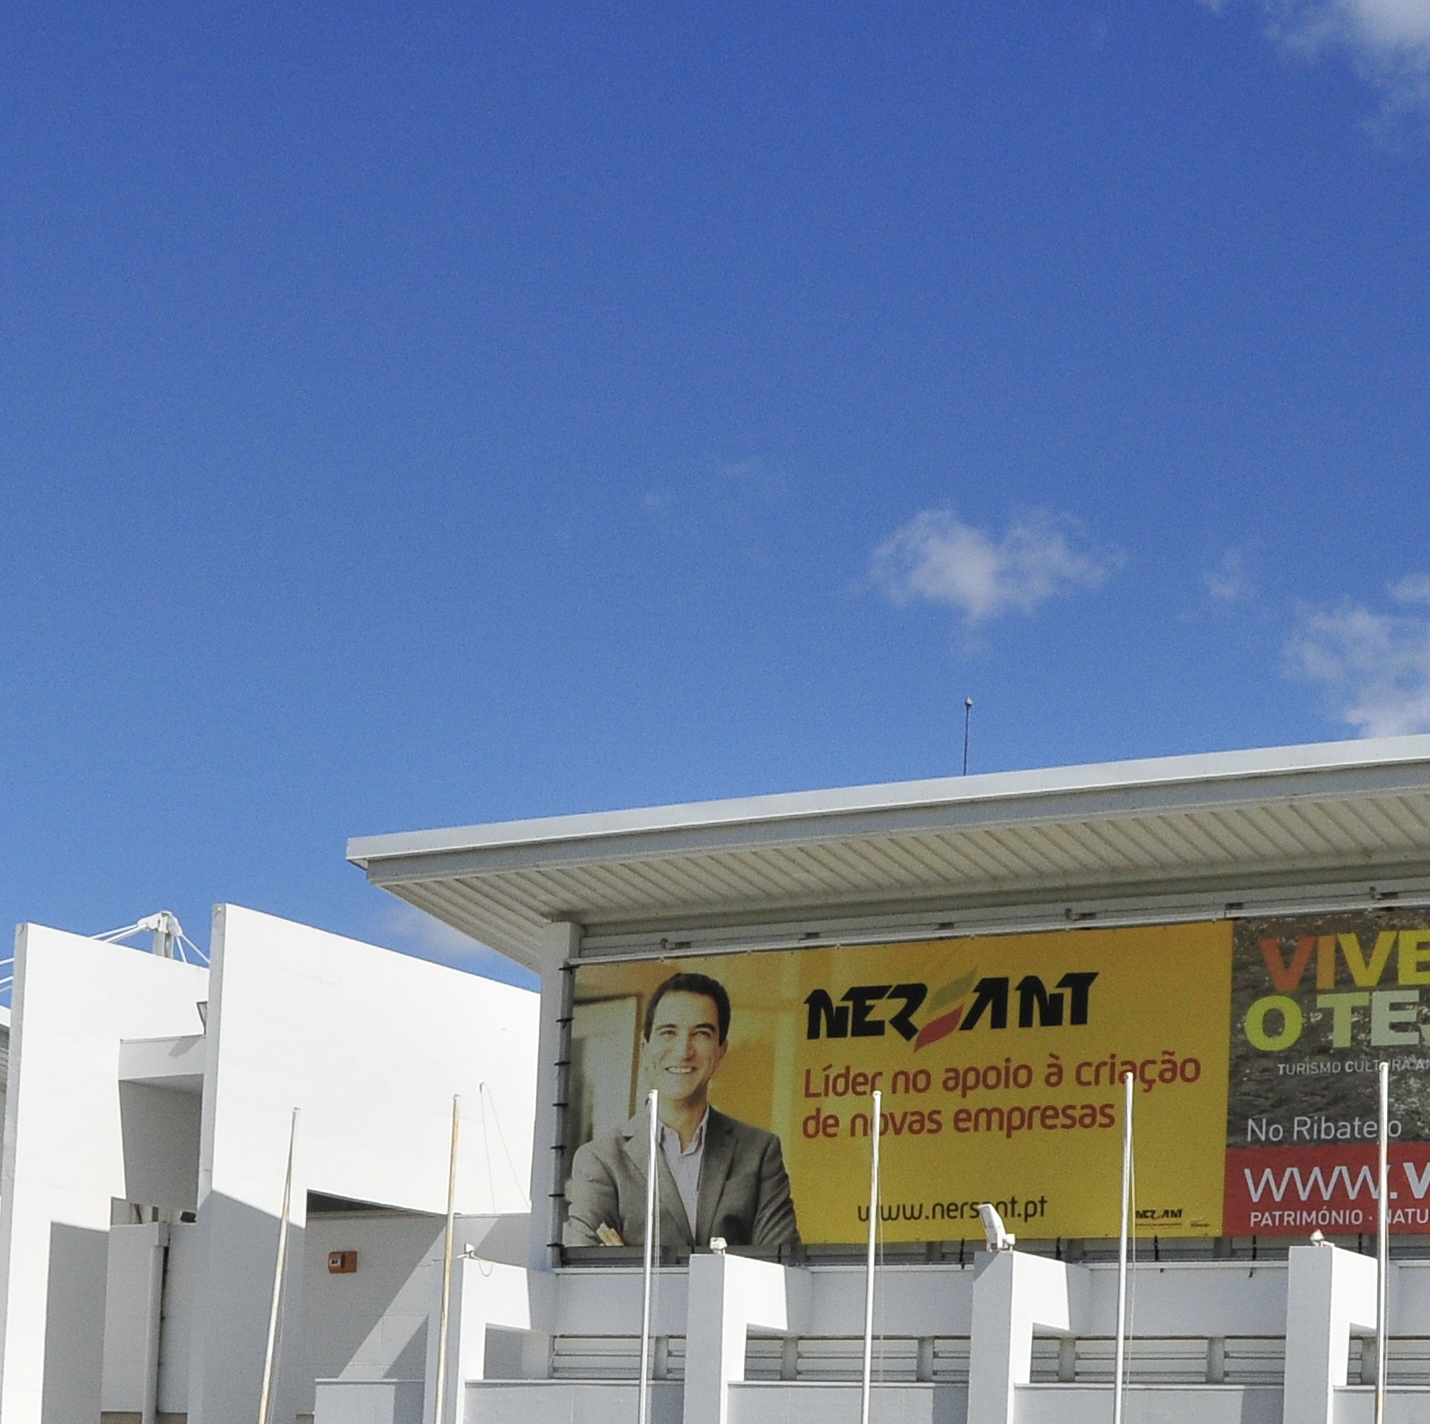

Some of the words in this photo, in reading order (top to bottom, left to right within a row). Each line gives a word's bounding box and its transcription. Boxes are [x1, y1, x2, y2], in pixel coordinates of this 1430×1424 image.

[1244, 995, 1304, 1051] O
[804, 1063, 883, 1098] Líder
[891, 1069, 932, 1095] no
[942, 1057, 1033, 1098] apoio
[1044, 1052, 1064, 1088] à
[1075, 1050, 1201, 1093] criação
[1277, 1060, 1342, 1076] TURISMO
[802, 1107, 840, 1139] de
[849, 1109, 944, 1138] novas
[953, 1103, 1116, 1139] empresas
[1247, 1117, 1284, 1142] No
[1293, 1116, 1402, 1141] Ribateo
[857, 1195, 1048, 1223] www.nersnt.pt
[1250, 1206, 1363, 1227] PATRIMÓNIO
